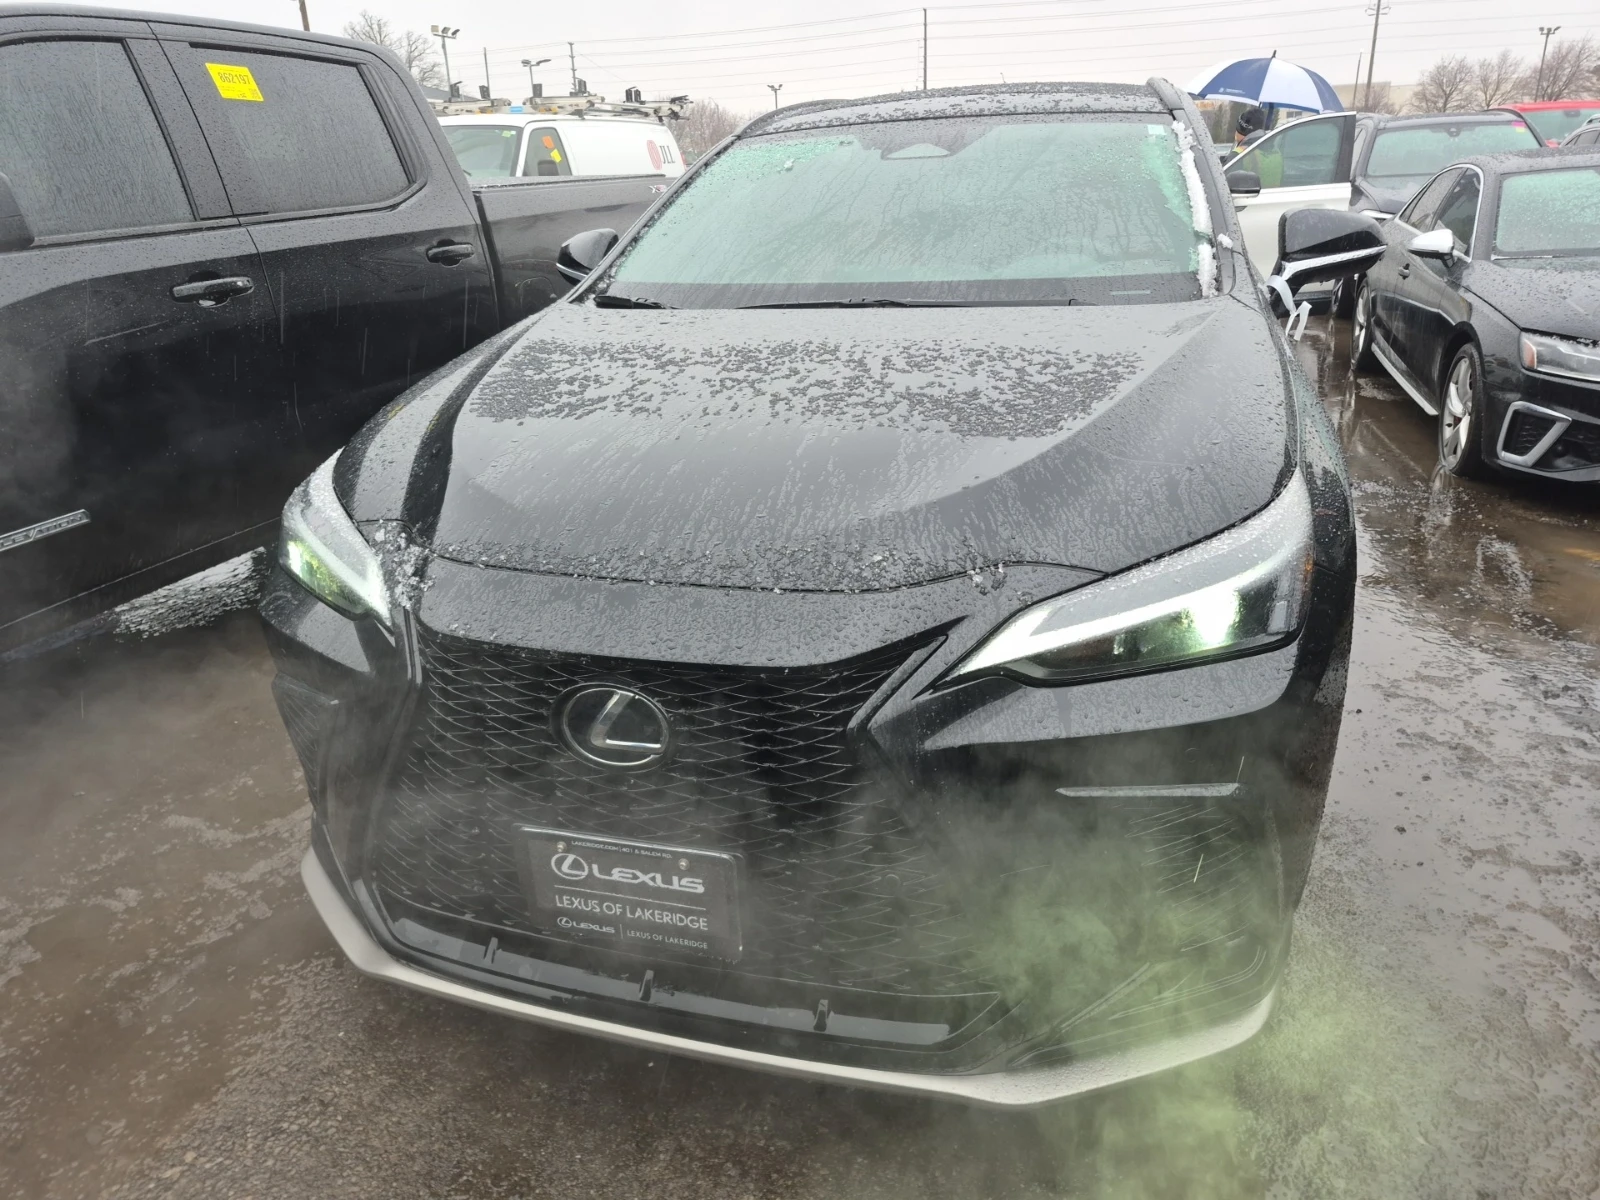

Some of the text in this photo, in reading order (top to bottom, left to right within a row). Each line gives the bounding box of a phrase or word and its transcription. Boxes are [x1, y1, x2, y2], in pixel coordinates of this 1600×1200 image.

[217, 72, 250, 84] 862197
[659, 146, 675, 164] JLL
[592, 863, 705, 894] LEXUS
[555, 894, 709, 931] LEXUS OF LAKERIDGE
[573, 921, 616, 934] LEXUS
[627, 929, 651, 941] LEXUS
[652, 933, 664, 942] OF
[665, 934, 709, 950] LAKERIDGE
